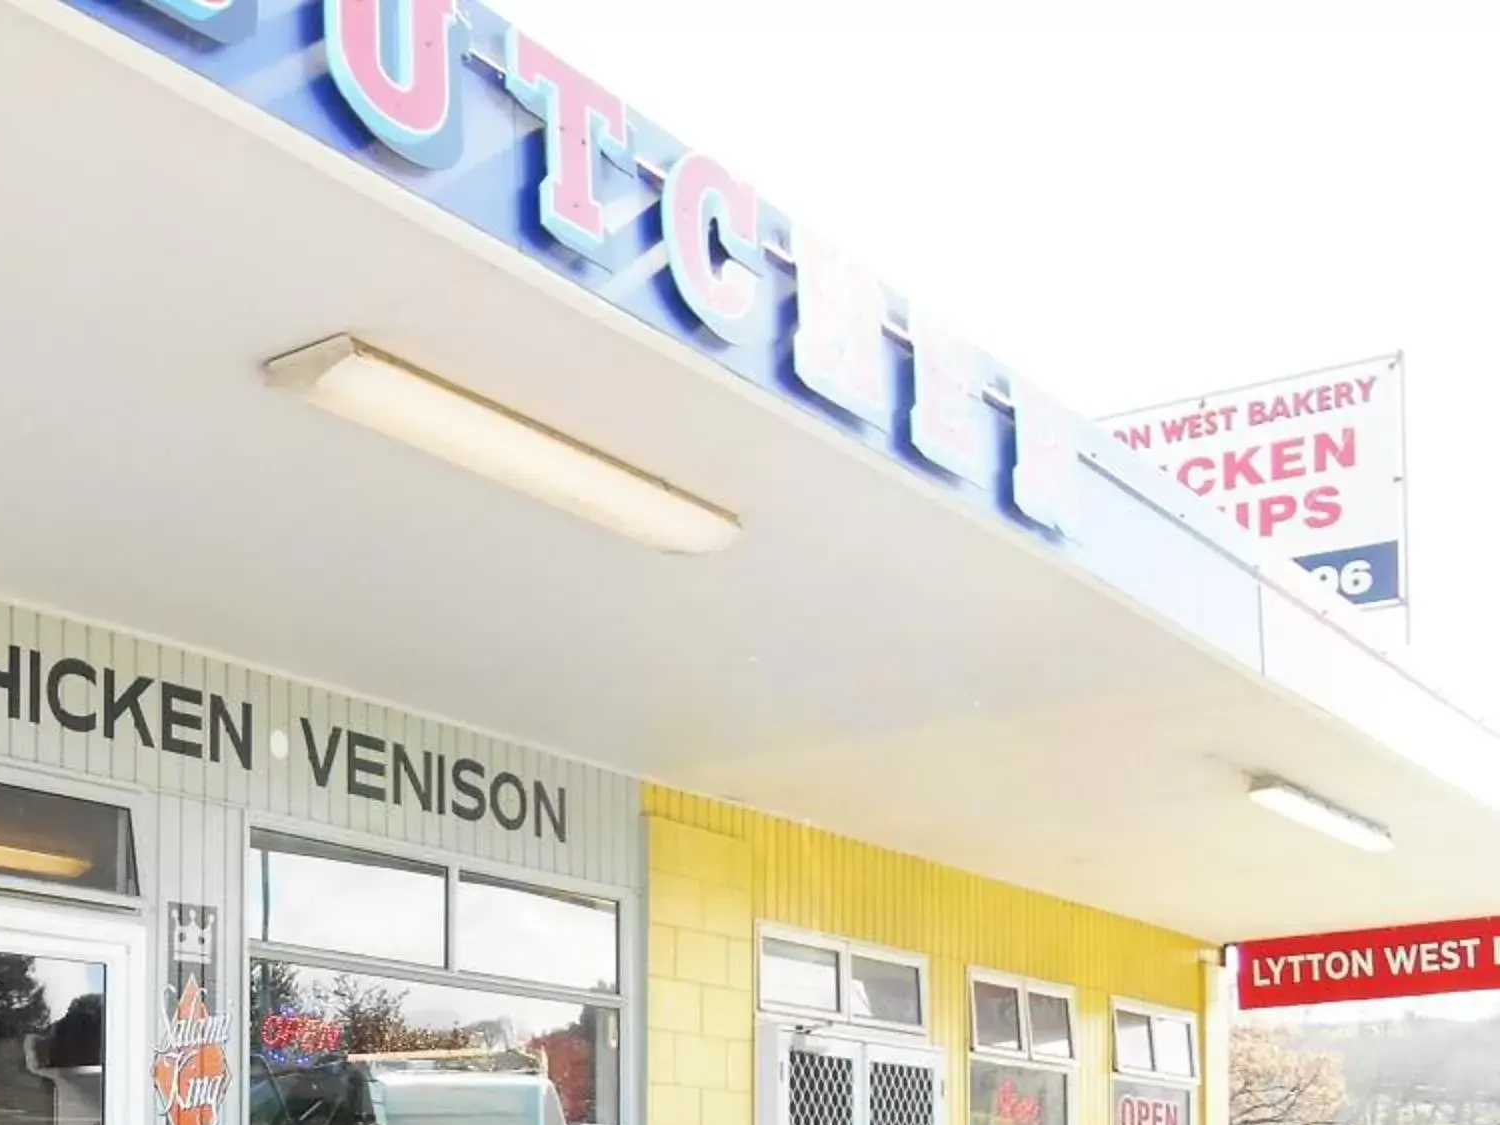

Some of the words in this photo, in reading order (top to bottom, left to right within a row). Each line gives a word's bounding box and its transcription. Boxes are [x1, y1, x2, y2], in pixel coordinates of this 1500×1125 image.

[1161, 406, 1238, 444] WEST
[1247, 375, 1377, 427] BAKERY
[1176, 427, 1357, 497] CKEN
[1235, 486, 1343, 538] IPS
[300, 716, 567, 844] VENISON
[1252, 948, 1374, 988] LYTTON
[1383, 938, 1481, 976] WEST
[155, 984, 232, 1054] Salami
[261, 1011, 344, 1053] OPEN
